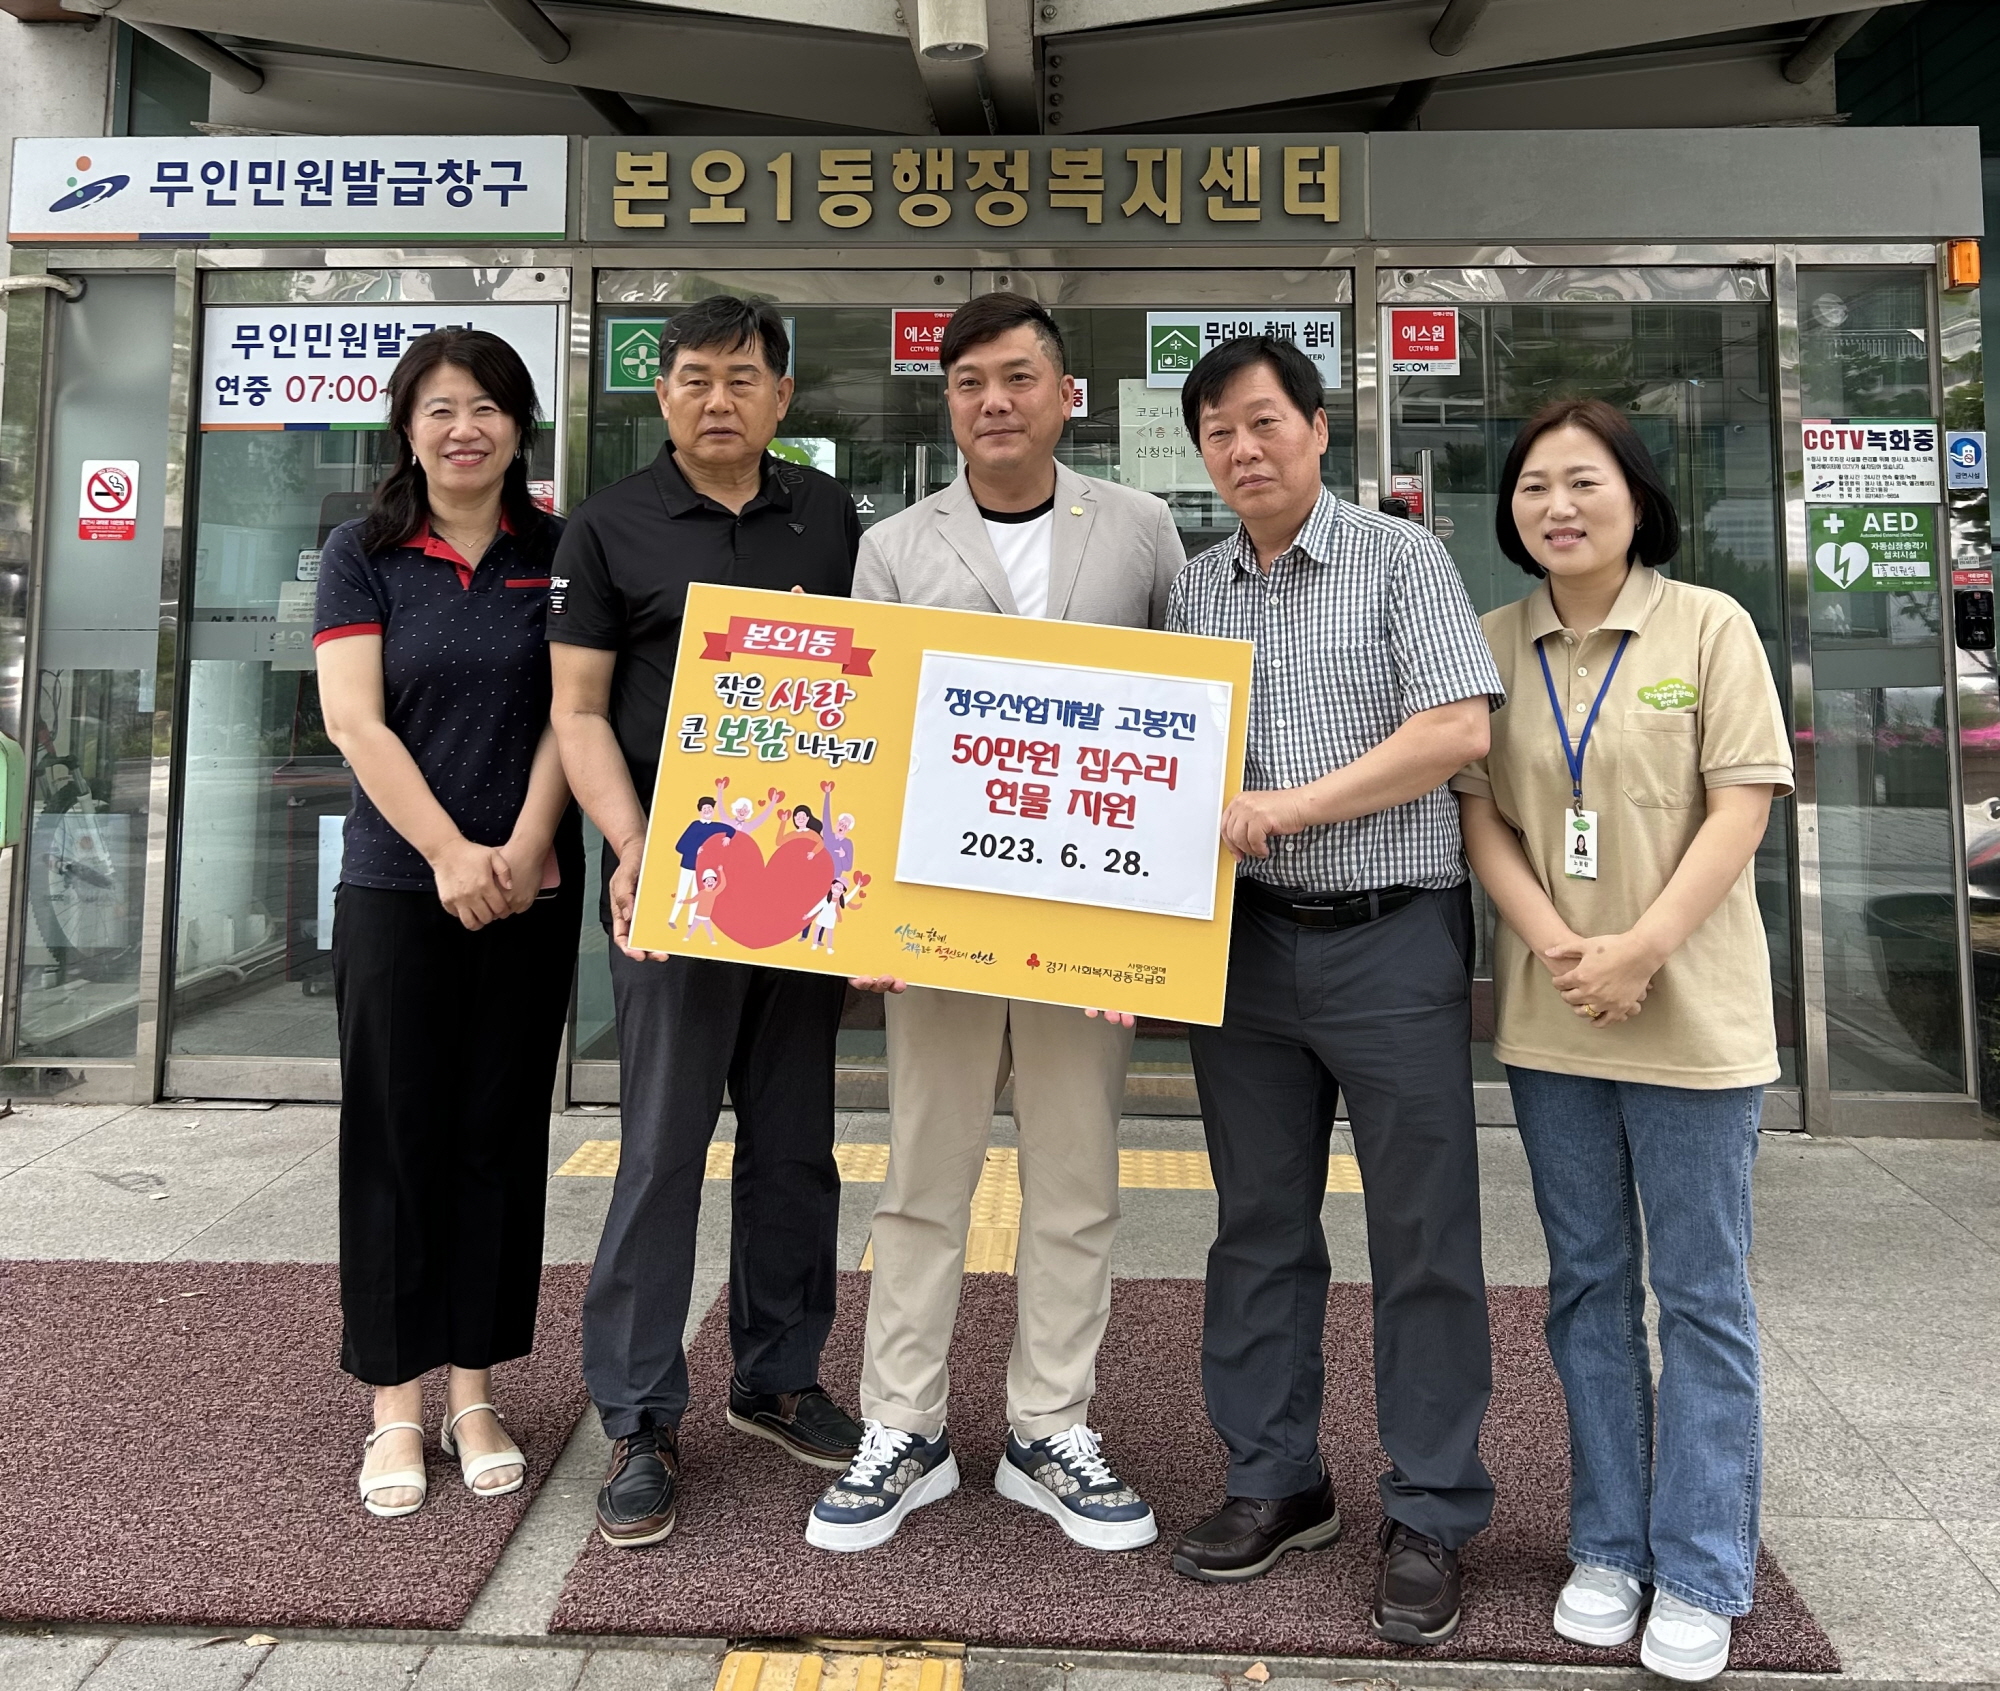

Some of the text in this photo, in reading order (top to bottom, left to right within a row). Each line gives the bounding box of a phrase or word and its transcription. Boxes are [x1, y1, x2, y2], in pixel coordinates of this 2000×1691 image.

[150, 159, 528, 208] 무인민원발급창구
[613, 146, 1341, 228] 본오1동행정복지센터
[231, 323, 472, 359] 무인민원발
[904, 326, 945, 342] 에스원
[1303, 322, 1334, 347] 쉼터
[1402, 325, 1445, 342] 에스원
[895, 363, 929, 372] SECOM
[1393, 362, 1429, 372] SECOM
[215, 375, 272, 406] 연중
[1136, 446, 1185, 458] 신청안내
[1863, 512, 1918, 532] AED
[1871, 541, 1928, 550] 자동심장충격기
[1884, 551, 1917, 559] 설치시설
[743, 622, 837, 657] 본오1동
[717, 675, 854, 727] 작은 사랑
[944, 687, 1196, 741] 정우산업개발 고봉진
[681, 717, 874, 764] 큰 보람 나누기
[951, 734, 1178, 791] 50만원 집수리
[1067, 789, 1136, 829] 지원
[960, 831, 1149, 877] 2023. 6. 28.
[970, 951, 997, 965] 안산
[1128, 963, 1166, 974] 사랑의열매
[1046, 961, 1166, 984] 경기 사회복지공동모금회
